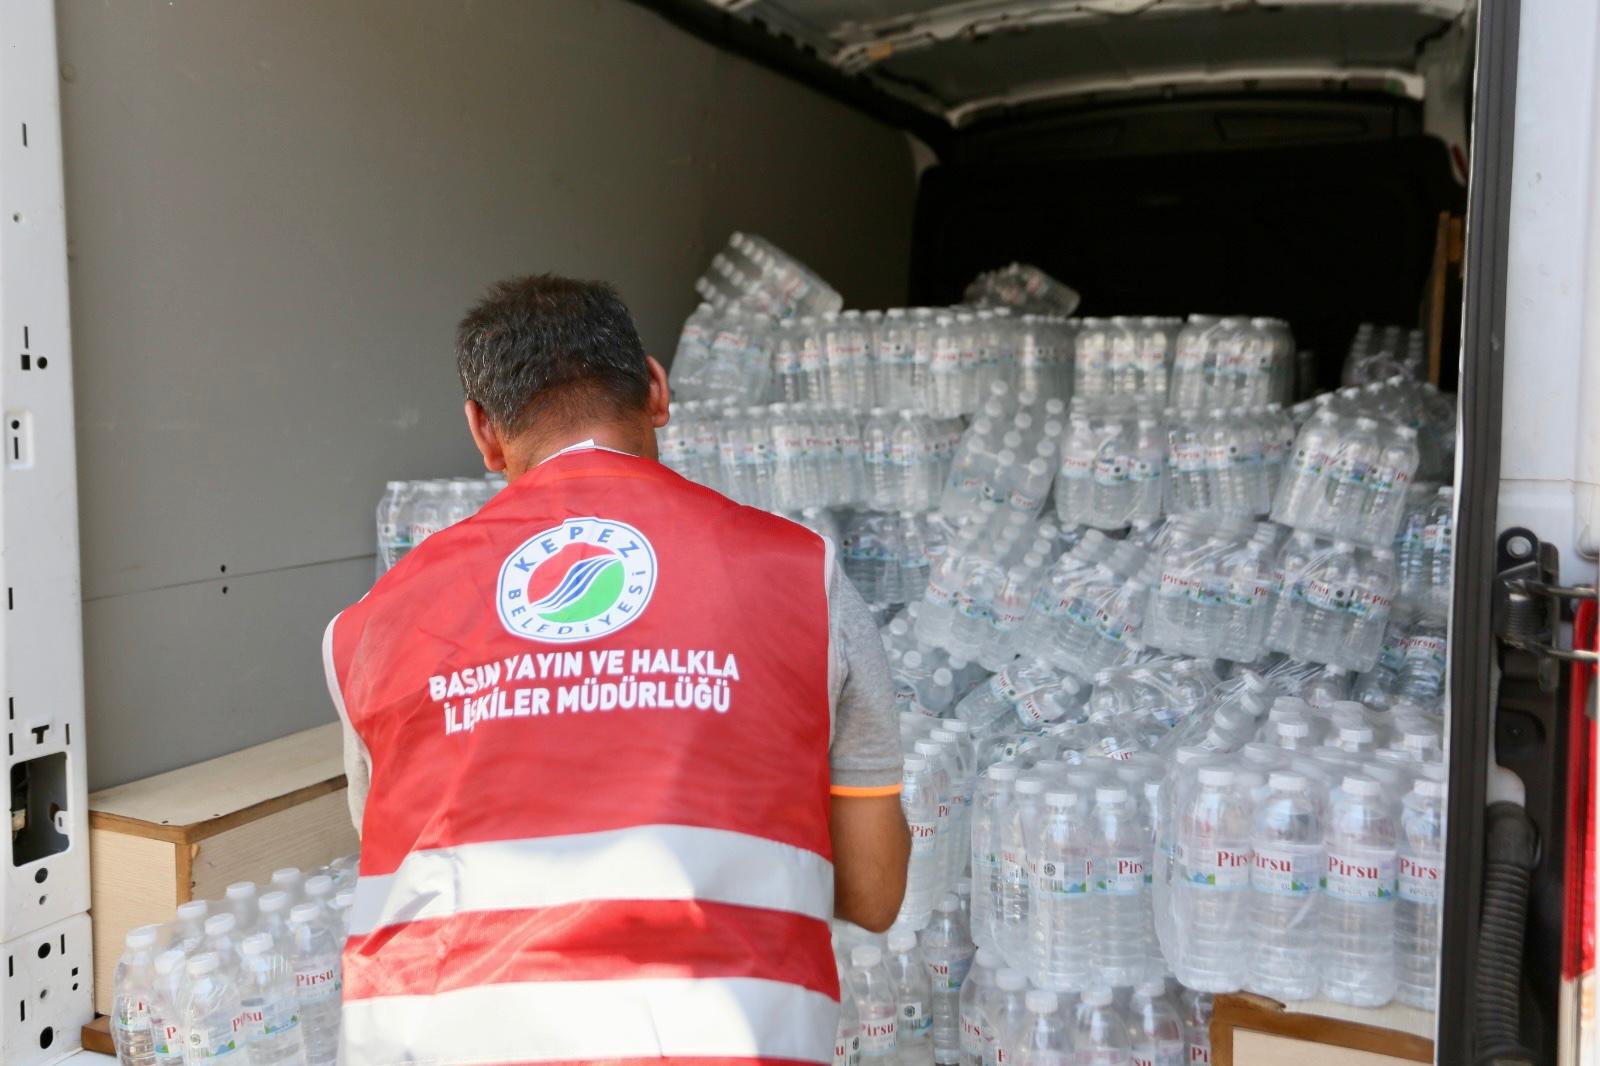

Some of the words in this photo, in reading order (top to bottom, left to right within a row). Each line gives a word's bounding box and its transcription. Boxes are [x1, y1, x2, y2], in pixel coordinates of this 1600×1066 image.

[514, 526, 639, 573] KEPEZ
[508, 569, 646, 635] BELEDİYESİ
[428, 662, 501, 701] BASIN
[504, 651, 583, 682] YAYIN
[589, 649, 624, 675] VE
[631, 649, 740, 681] HALKLA
[444, 686, 550, 735] İLİŞKİLER
[557, 676, 731, 713] MÜDÜRLÜĞÜ
[1118, 860, 1143, 875] Pirs
[1217, 850, 1249, 868] Pirs
[1328, 856, 1379, 880] Pirsu
[1400, 857, 1438, 880] Pirs
[295, 969, 335, 988] Pirsu
